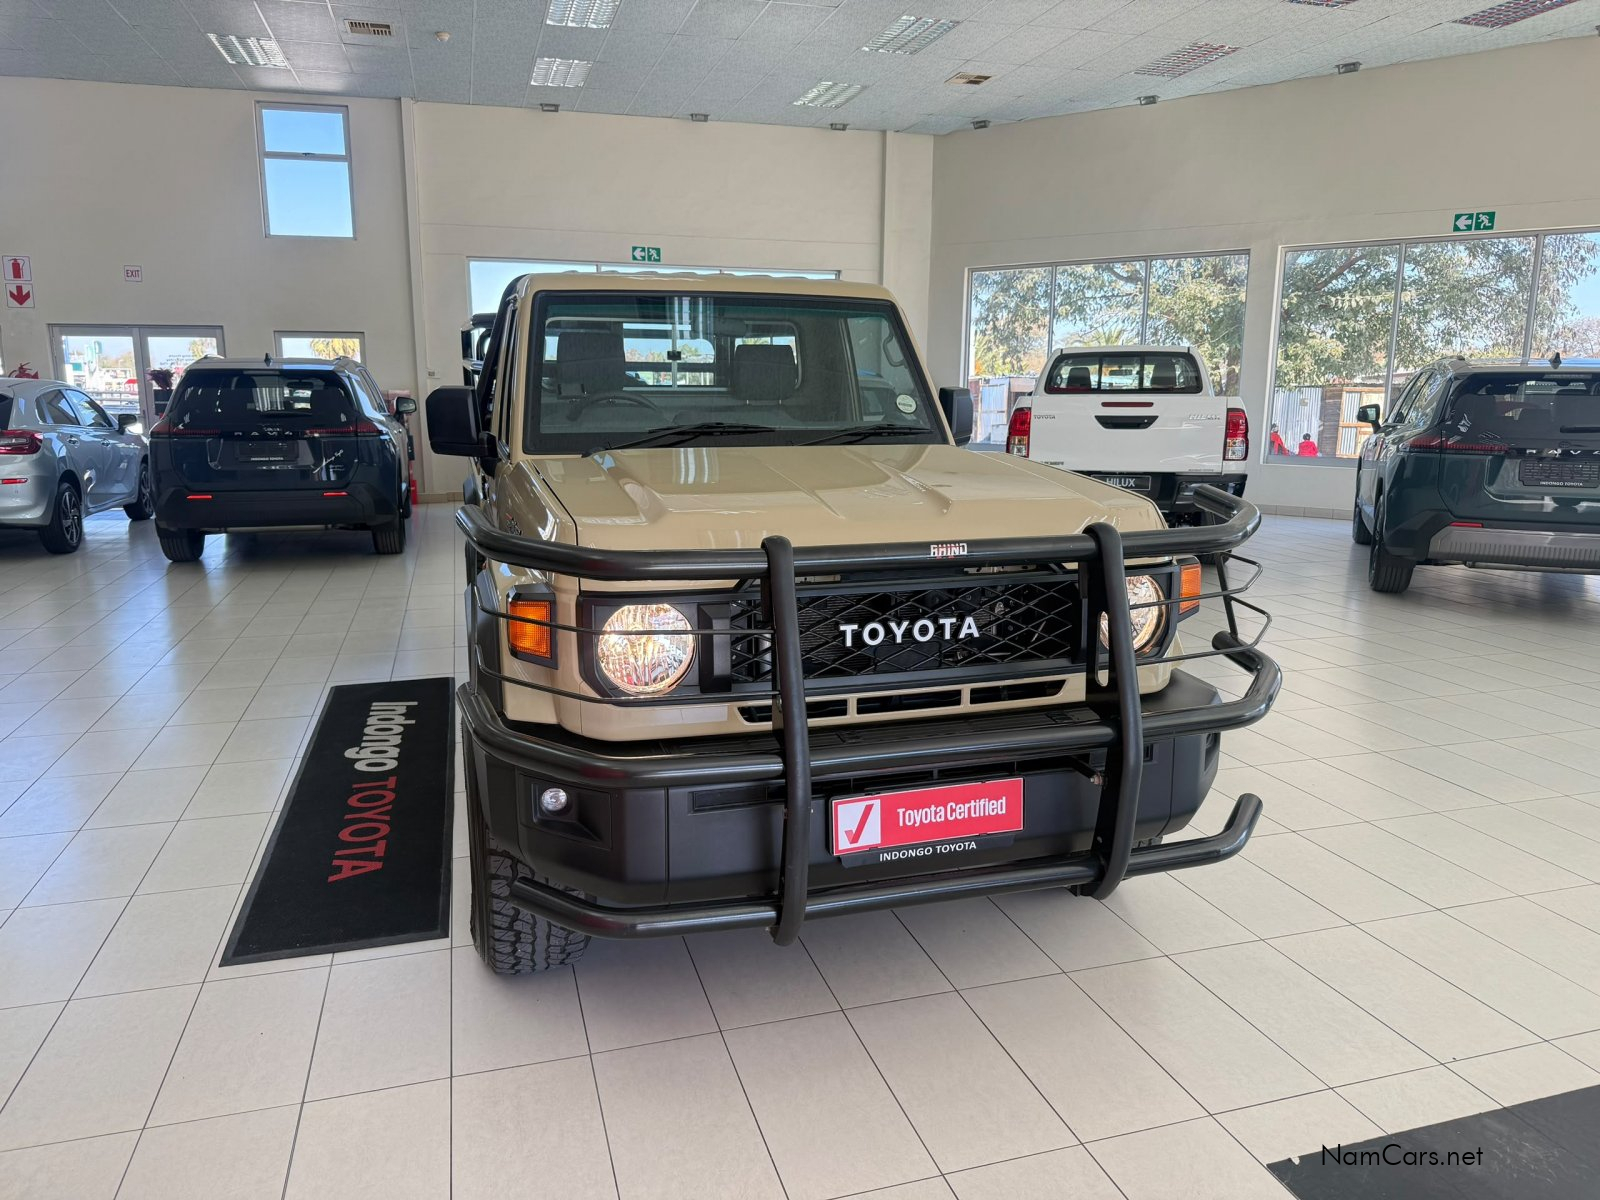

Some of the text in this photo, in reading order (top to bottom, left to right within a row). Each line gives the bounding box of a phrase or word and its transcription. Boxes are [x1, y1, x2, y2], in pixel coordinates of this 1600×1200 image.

[125, 269, 140, 279] EXIT
[1106, 477, 1136, 488] HILUX
[839, 616, 980, 648] TOYOTA
[327, 701, 419, 883] Indongo TOYOTA
[896, 796, 1007, 828] Toyota Certified
[879, 841, 978, 862] INDONGO TOYOTA
